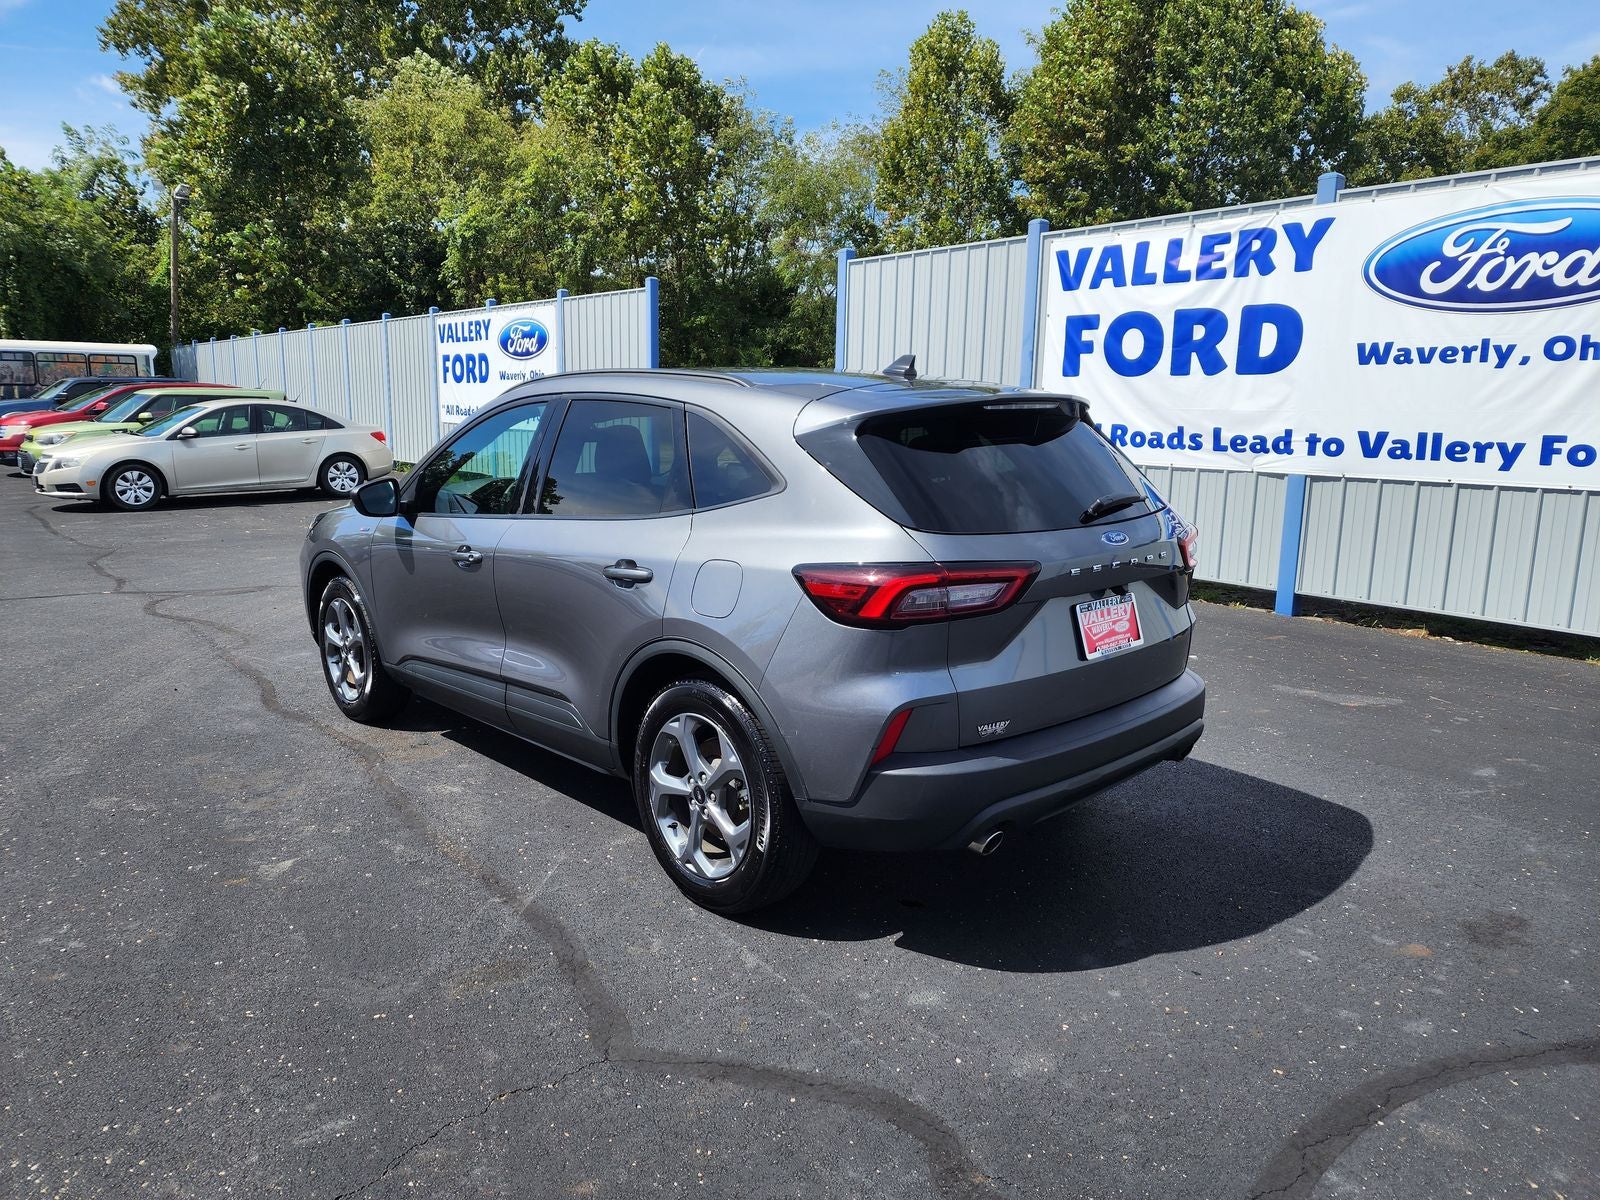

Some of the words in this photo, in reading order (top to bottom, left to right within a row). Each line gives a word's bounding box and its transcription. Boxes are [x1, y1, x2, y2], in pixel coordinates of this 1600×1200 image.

[1055, 216, 1336, 292] VALLERY
[438, 318, 492, 344] VALLERY
[507, 325, 539, 354] Ford
[1062, 303, 1304, 377] FORD
[442, 353, 490, 384] FORD
[1110, 422, 1204, 451] Roads
[1212, 427, 1293, 457] Lead
[1305, 433, 1345, 457] to
[1357, 430, 1527, 472] Vallery
[1080, 602, 1132, 626] VALLERY
[1091, 596, 1121, 610] VALLERY
[977, 719, 1011, 732] VALLERY
